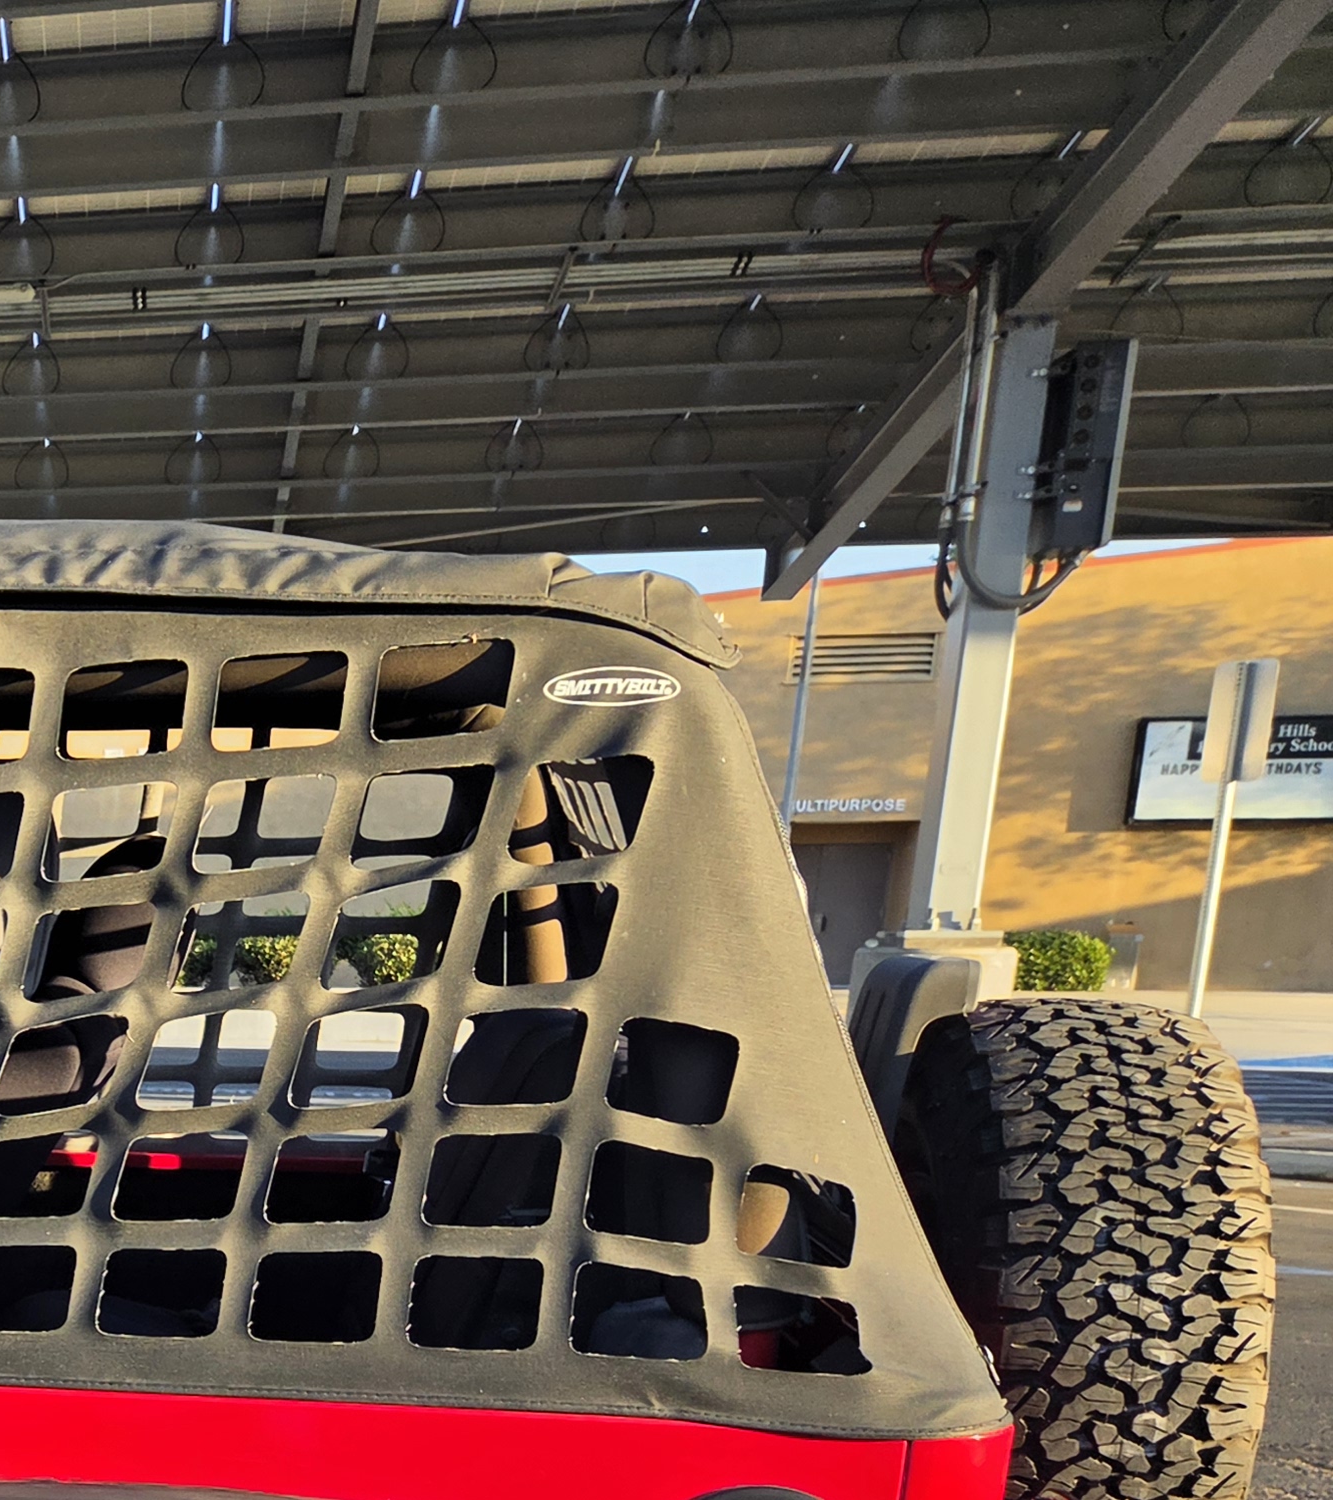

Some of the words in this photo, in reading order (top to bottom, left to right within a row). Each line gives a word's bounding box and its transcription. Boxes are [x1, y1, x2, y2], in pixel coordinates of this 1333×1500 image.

[553, 677, 667, 696] SMITTYBILT
[1278, 723, 1317, 738] Hills
[1289, 737, 1333, 752] Schoo
[1160, 762, 1199, 776] HAPP
[1266, 762, 1322, 775] THDAYS
[795, 798, 906, 813] ULTIPURPOSE
